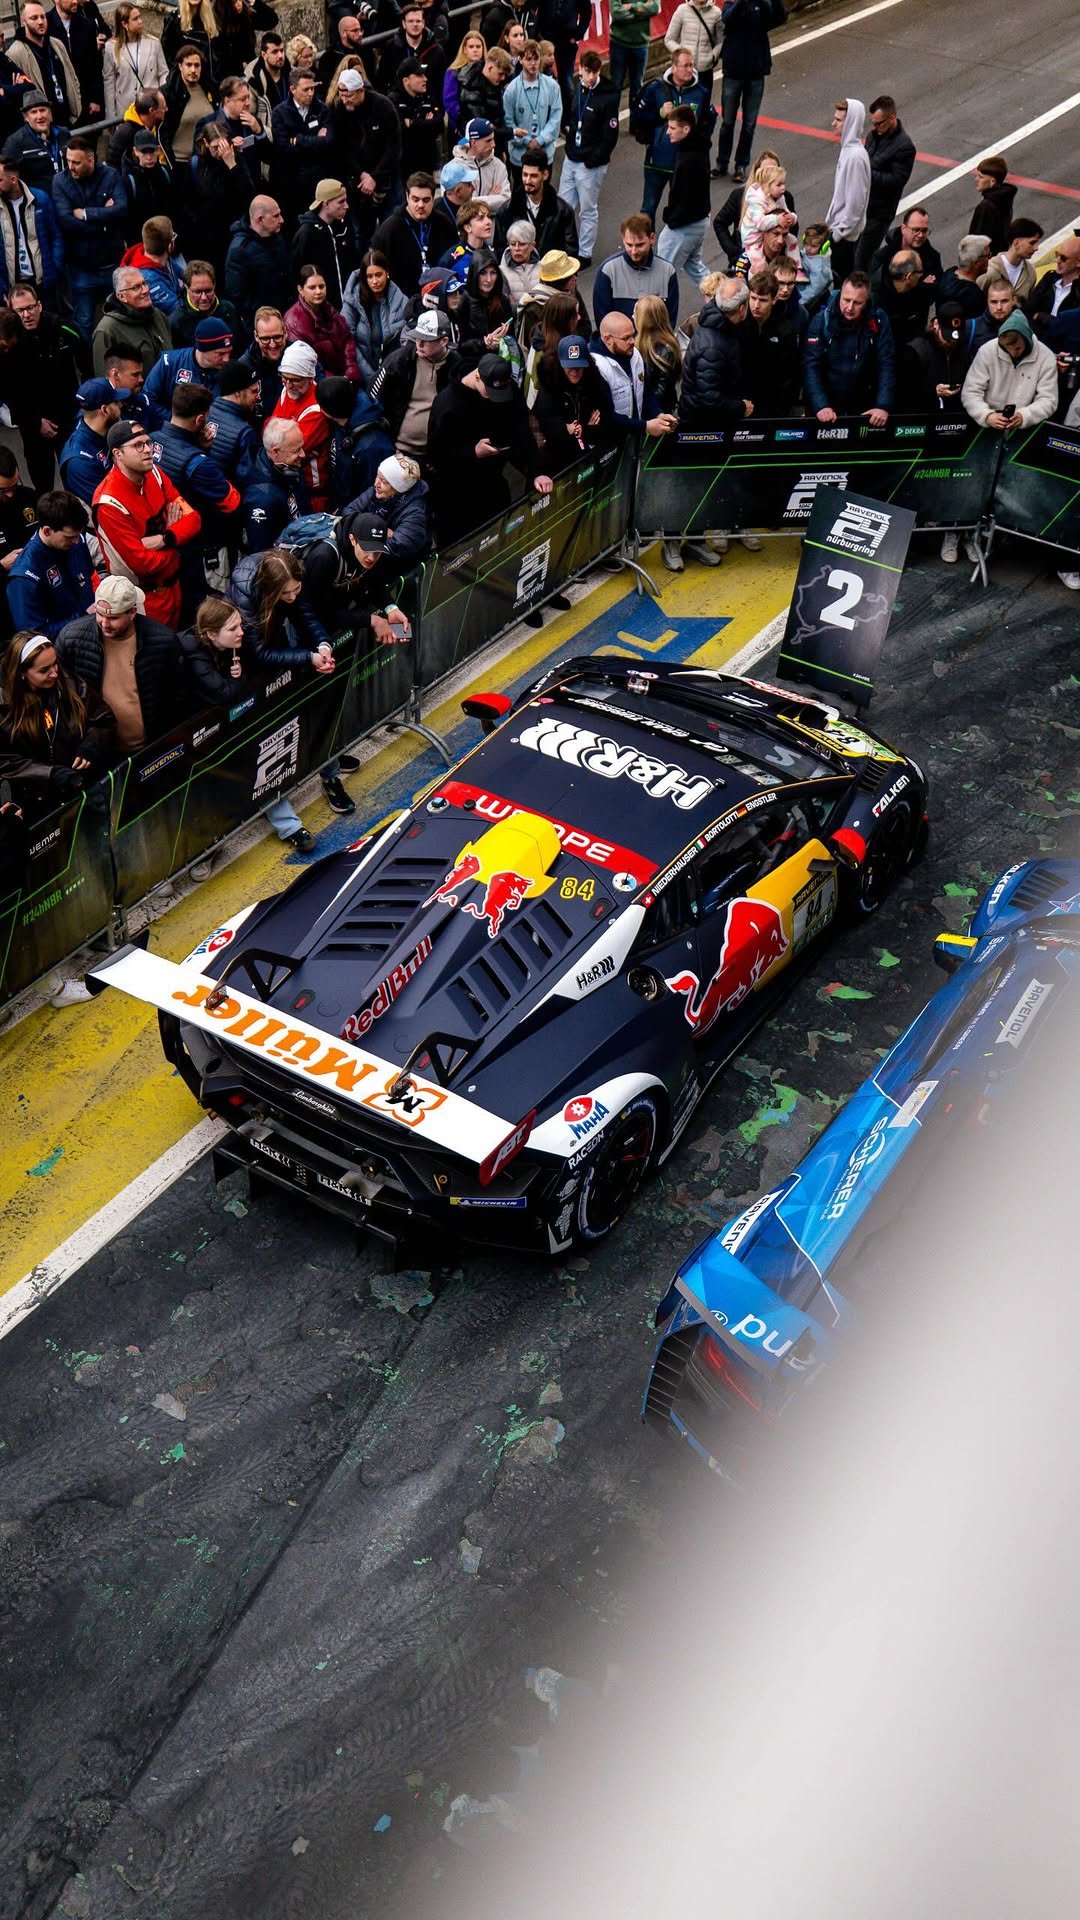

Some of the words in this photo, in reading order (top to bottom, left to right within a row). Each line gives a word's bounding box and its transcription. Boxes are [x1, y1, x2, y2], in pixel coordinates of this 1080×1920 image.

[803, 473, 845, 481] RAVENOL
[830, 511, 890, 549] 24
[848, 505, 887, 521] RAVENOL
[826, 535, 876, 558] nürburgring
[819, 568, 864, 631] 2
[261, 721, 297, 750] RAVENOL
[144, 750, 180, 777] RAVENOL
[254, 727, 300, 790] 24
[579, 736, 716, 810] H&R
[252, 763, 298, 801] nürburgring
[872, 775, 910, 818] FALKEN
[474, 795, 616, 863] WPE
[704, 809, 740, 842] BORTOLOTTI
[745, 792, 777, 811] ENGSTLER
[559, 876, 596, 901] 84
[340, 982, 391, 1042] Red
[386, 934, 433, 1001] Bull
[575, 965, 602, 990] H&R
[1004, 985, 1044, 1039] RAVENOL
[171, 984, 379, 1092] Müller
[295, 1089, 336, 1115] Lamborghini
[567, 1100, 610, 1141] MAHA
[490, 1123, 528, 1177] ABT
[568, 1129, 605, 1170] RACEON
[826, 1116, 890, 1221] SCHERER
